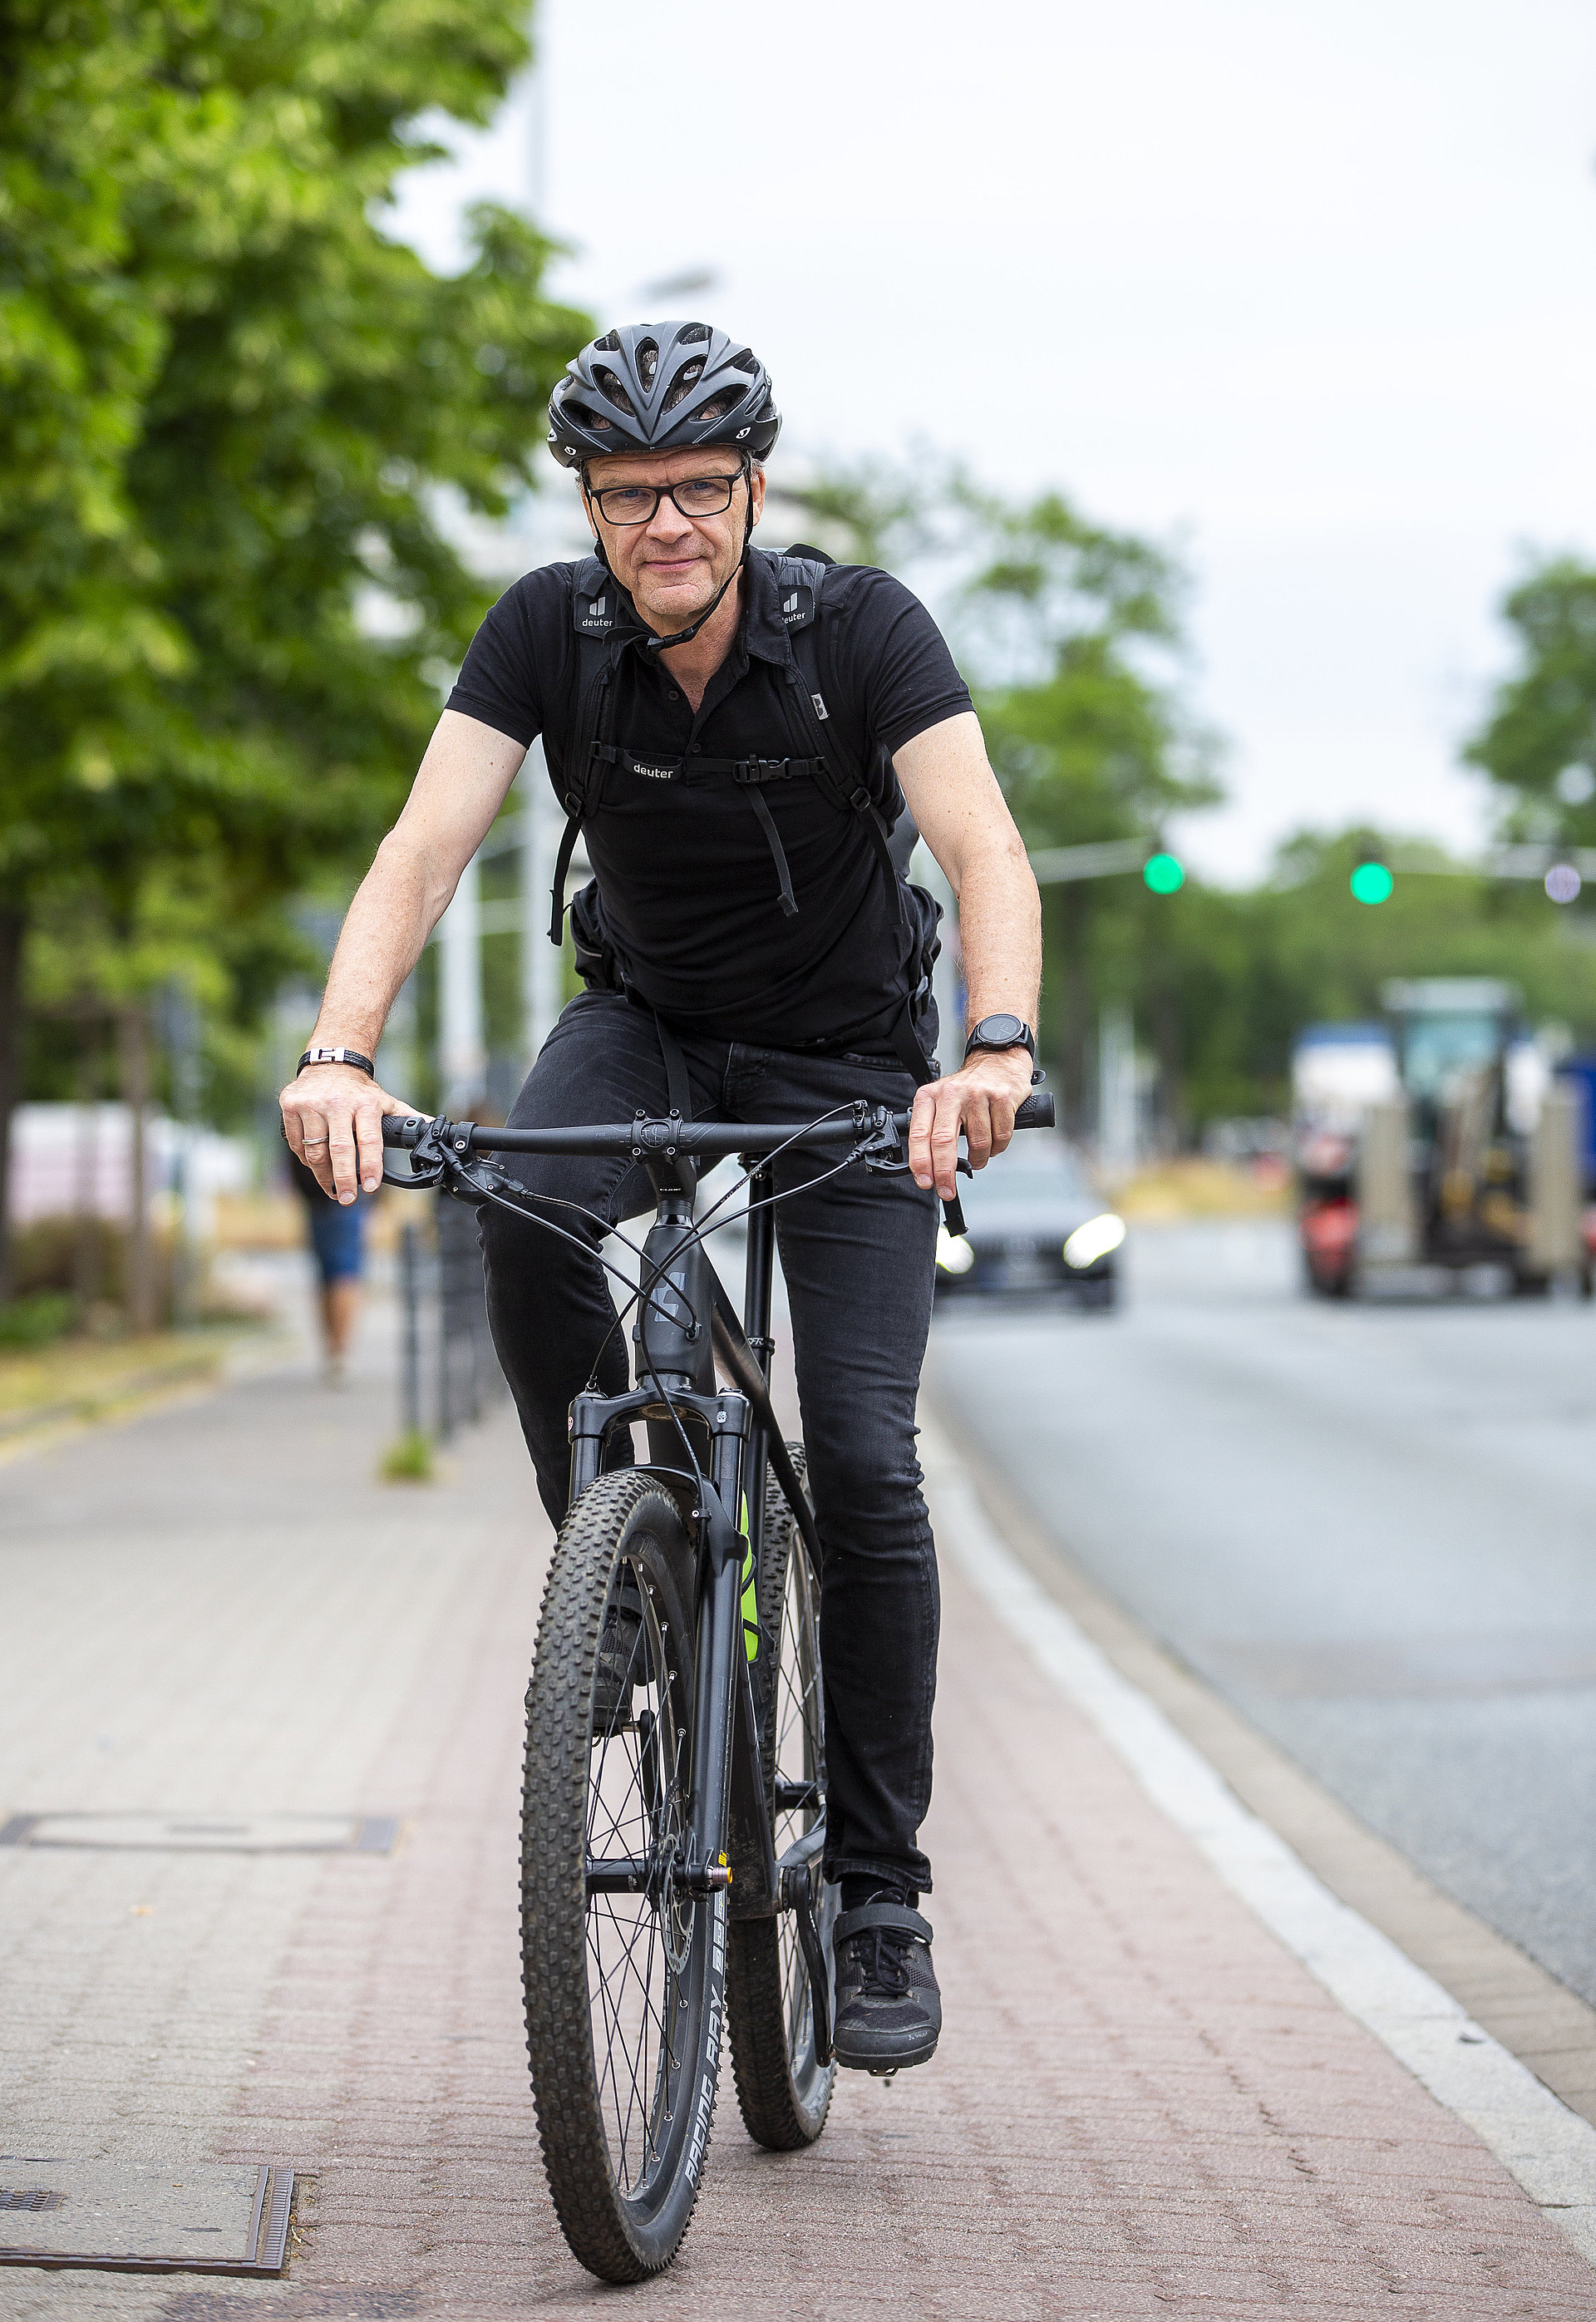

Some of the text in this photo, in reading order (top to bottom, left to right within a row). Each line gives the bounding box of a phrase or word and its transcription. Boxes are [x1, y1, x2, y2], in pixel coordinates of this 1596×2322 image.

[582, 619, 613, 627] deuter
[781, 612, 805, 624] euter
[633, 764, 674, 779] deuter
[684, 2073, 714, 2189] RACING
[707, 1983, 722, 2069] RAY
